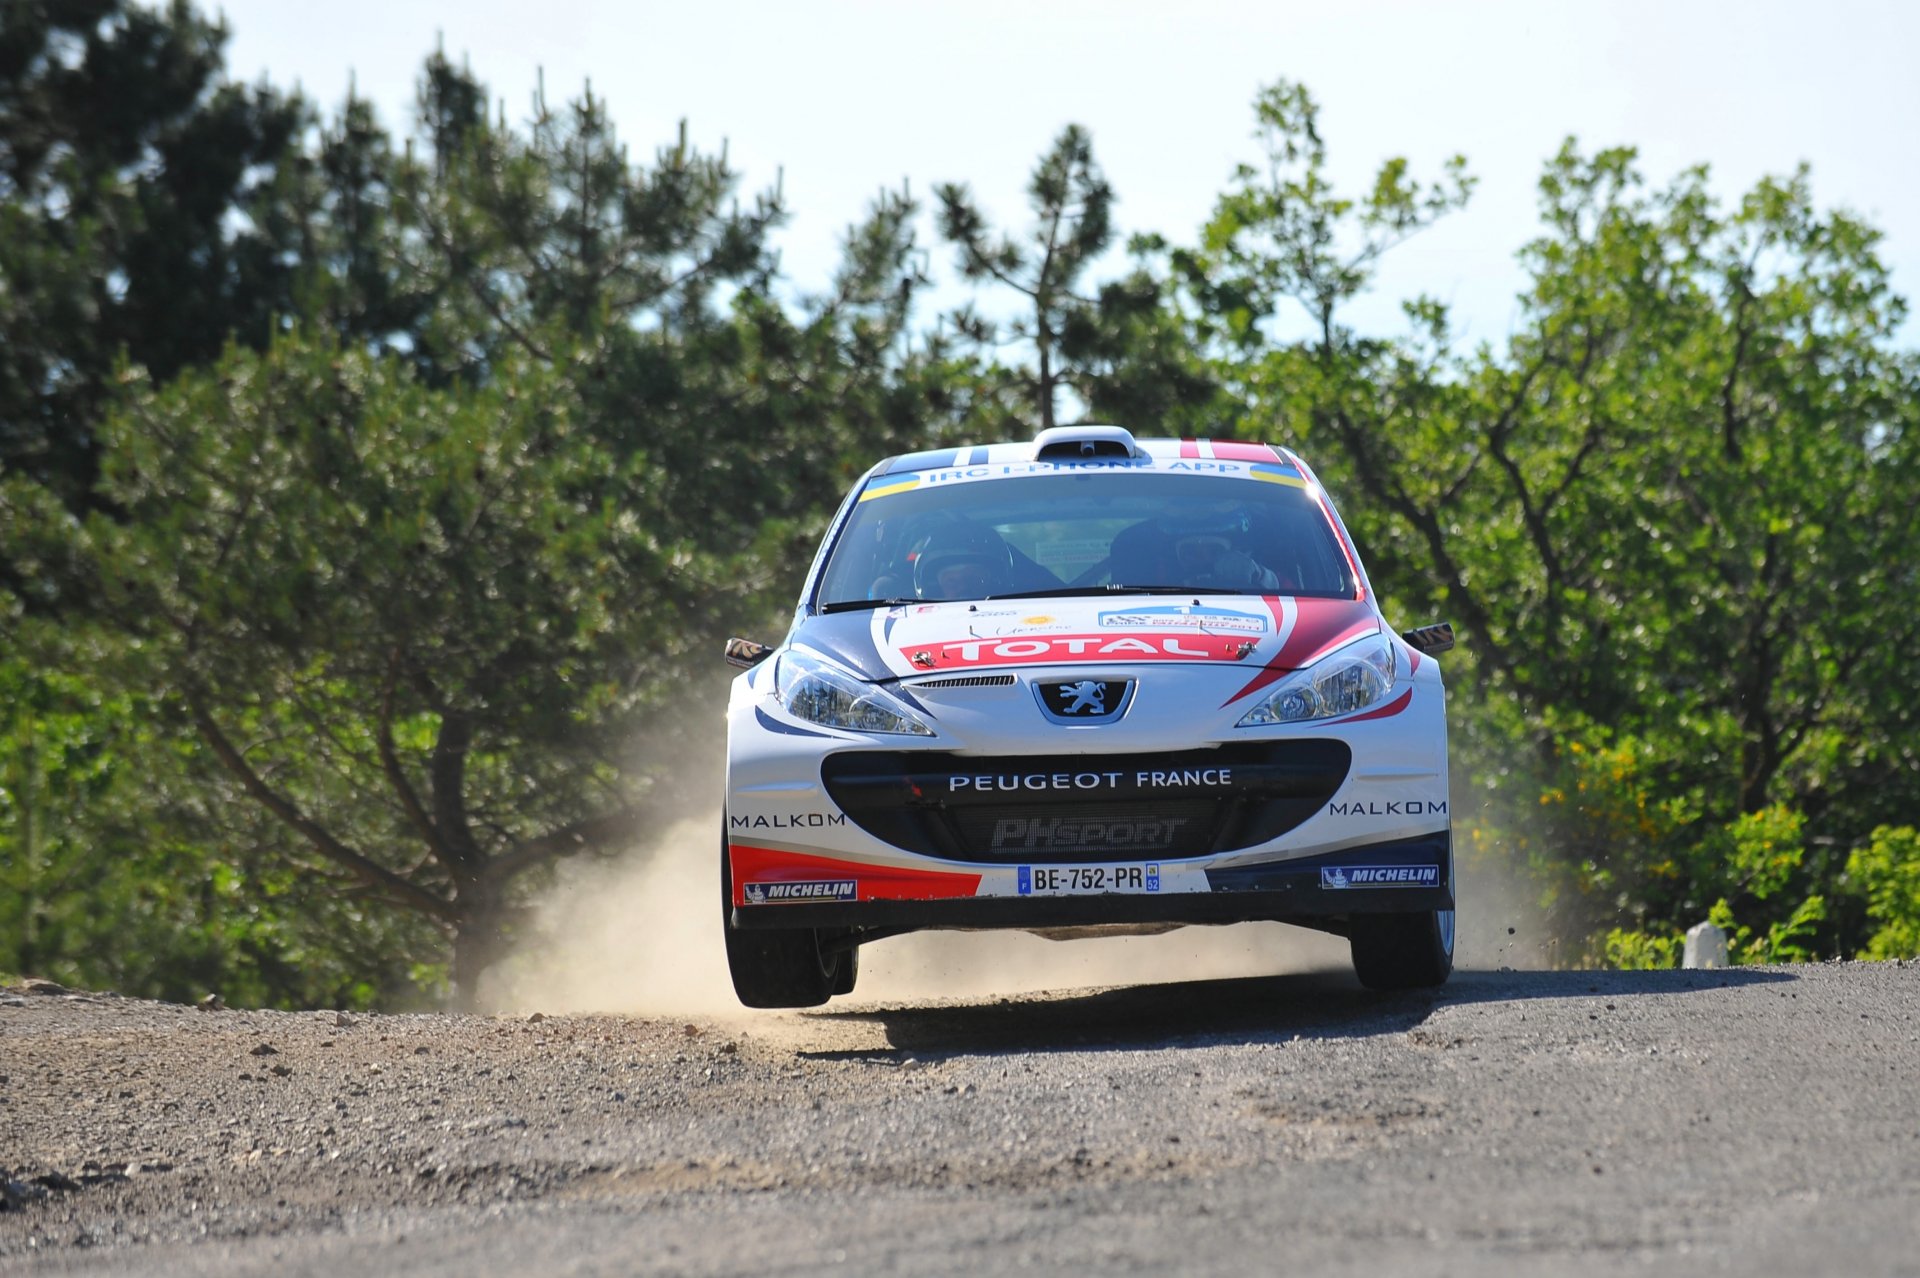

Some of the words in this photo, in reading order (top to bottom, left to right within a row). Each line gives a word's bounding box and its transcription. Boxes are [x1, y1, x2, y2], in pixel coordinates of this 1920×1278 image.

[929, 467, 990, 483] IRC
[1168, 461, 1241, 473] APP
[1173, 606, 1191, 615] 1
[943, 638, 1209, 661] TOTAL
[949, 773, 1124, 792] PEUGEOT
[1136, 769, 1232, 788] FRANCE
[1329, 801, 1447, 816] MALKOM
[731, 813, 846, 828] MALKOM
[1034, 867, 1143, 890] BE-752-PR
[1147, 879, 1159, 890] 52
[1351, 868, 1436, 882] MICHELIN
[768, 882, 854, 898] MICHELIN
